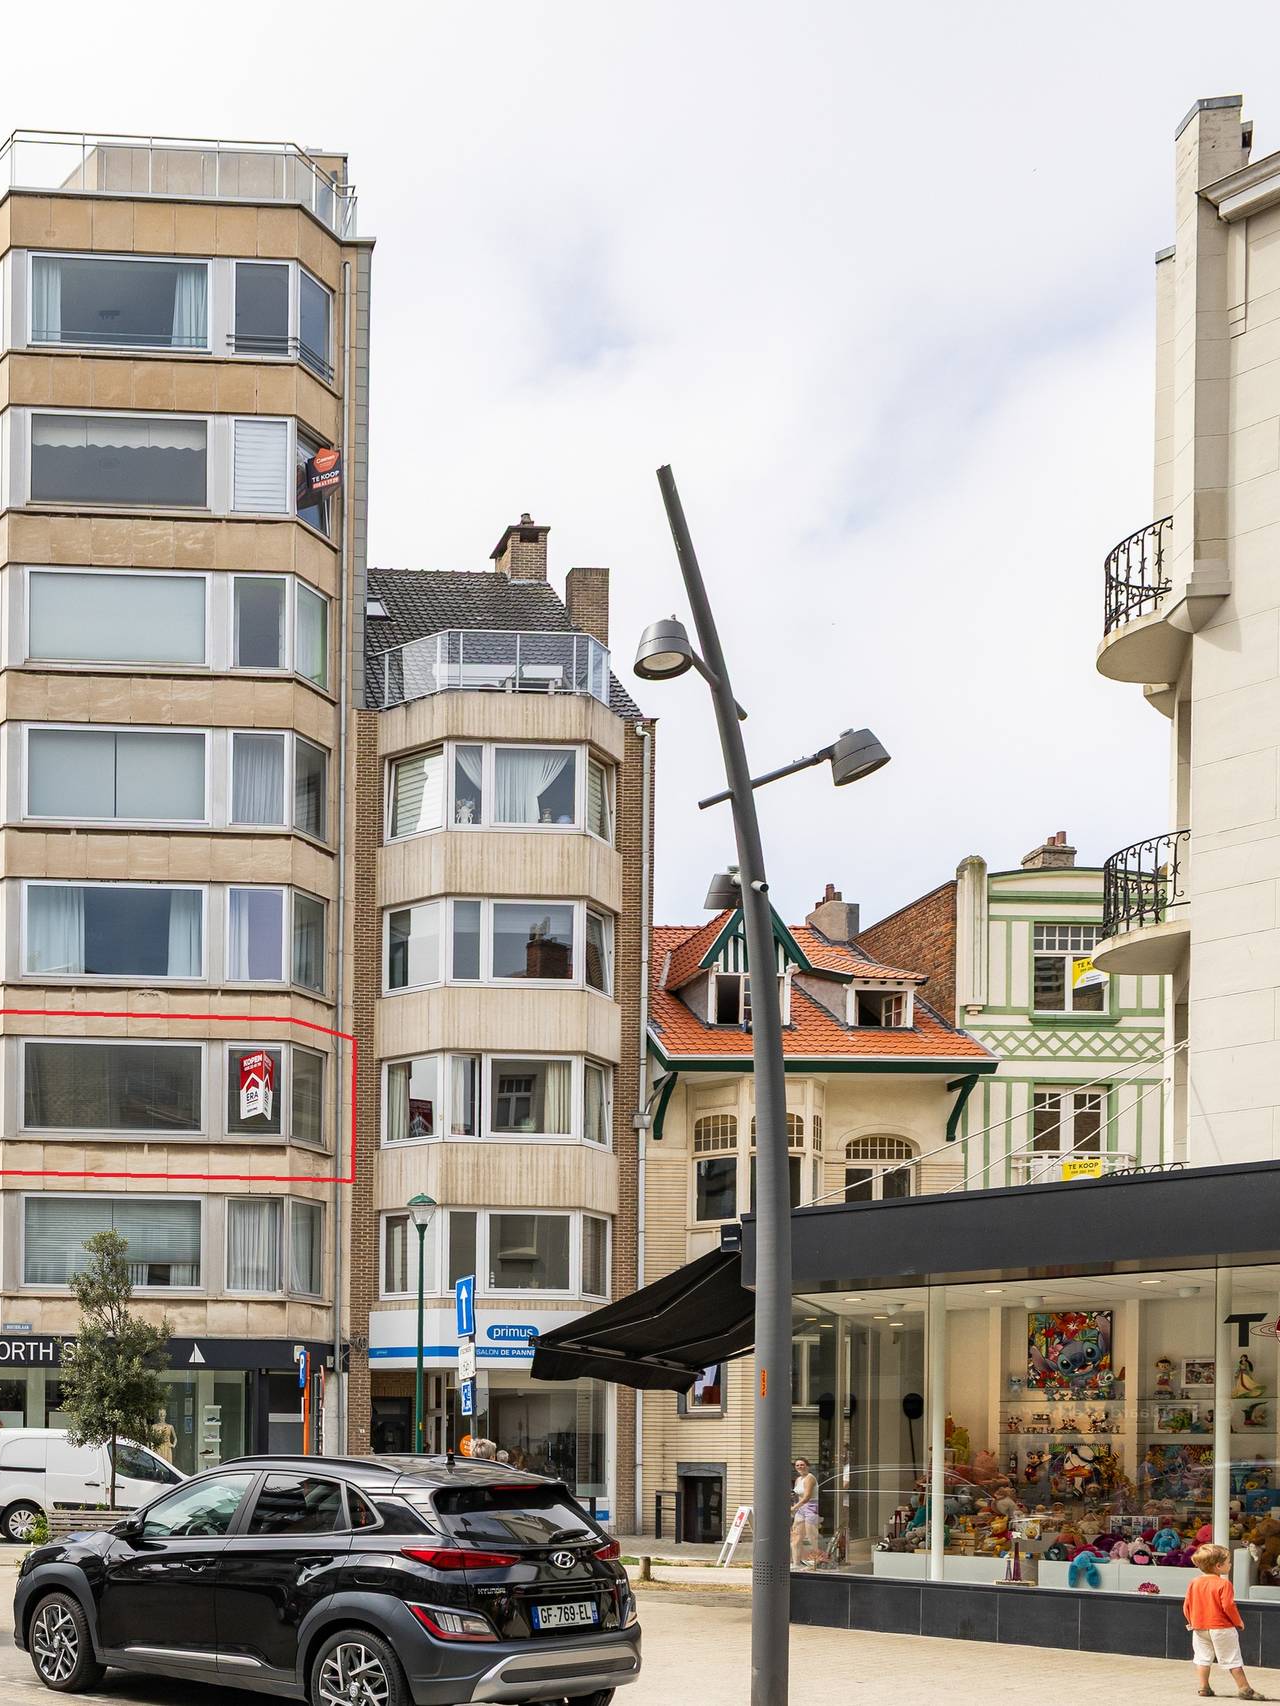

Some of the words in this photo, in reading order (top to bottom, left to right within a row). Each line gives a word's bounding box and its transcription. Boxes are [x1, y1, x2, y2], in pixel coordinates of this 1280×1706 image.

[320, 470, 340, 480] KOOP
[243, 1053, 263, 1067] KOPEN
[246, 1090, 259, 1101] ERA
[493, 1325, 534, 1339] primus
[476, 1348, 499, 1356] SALON
[540, 1603, 592, 1625] GF-769-EL
